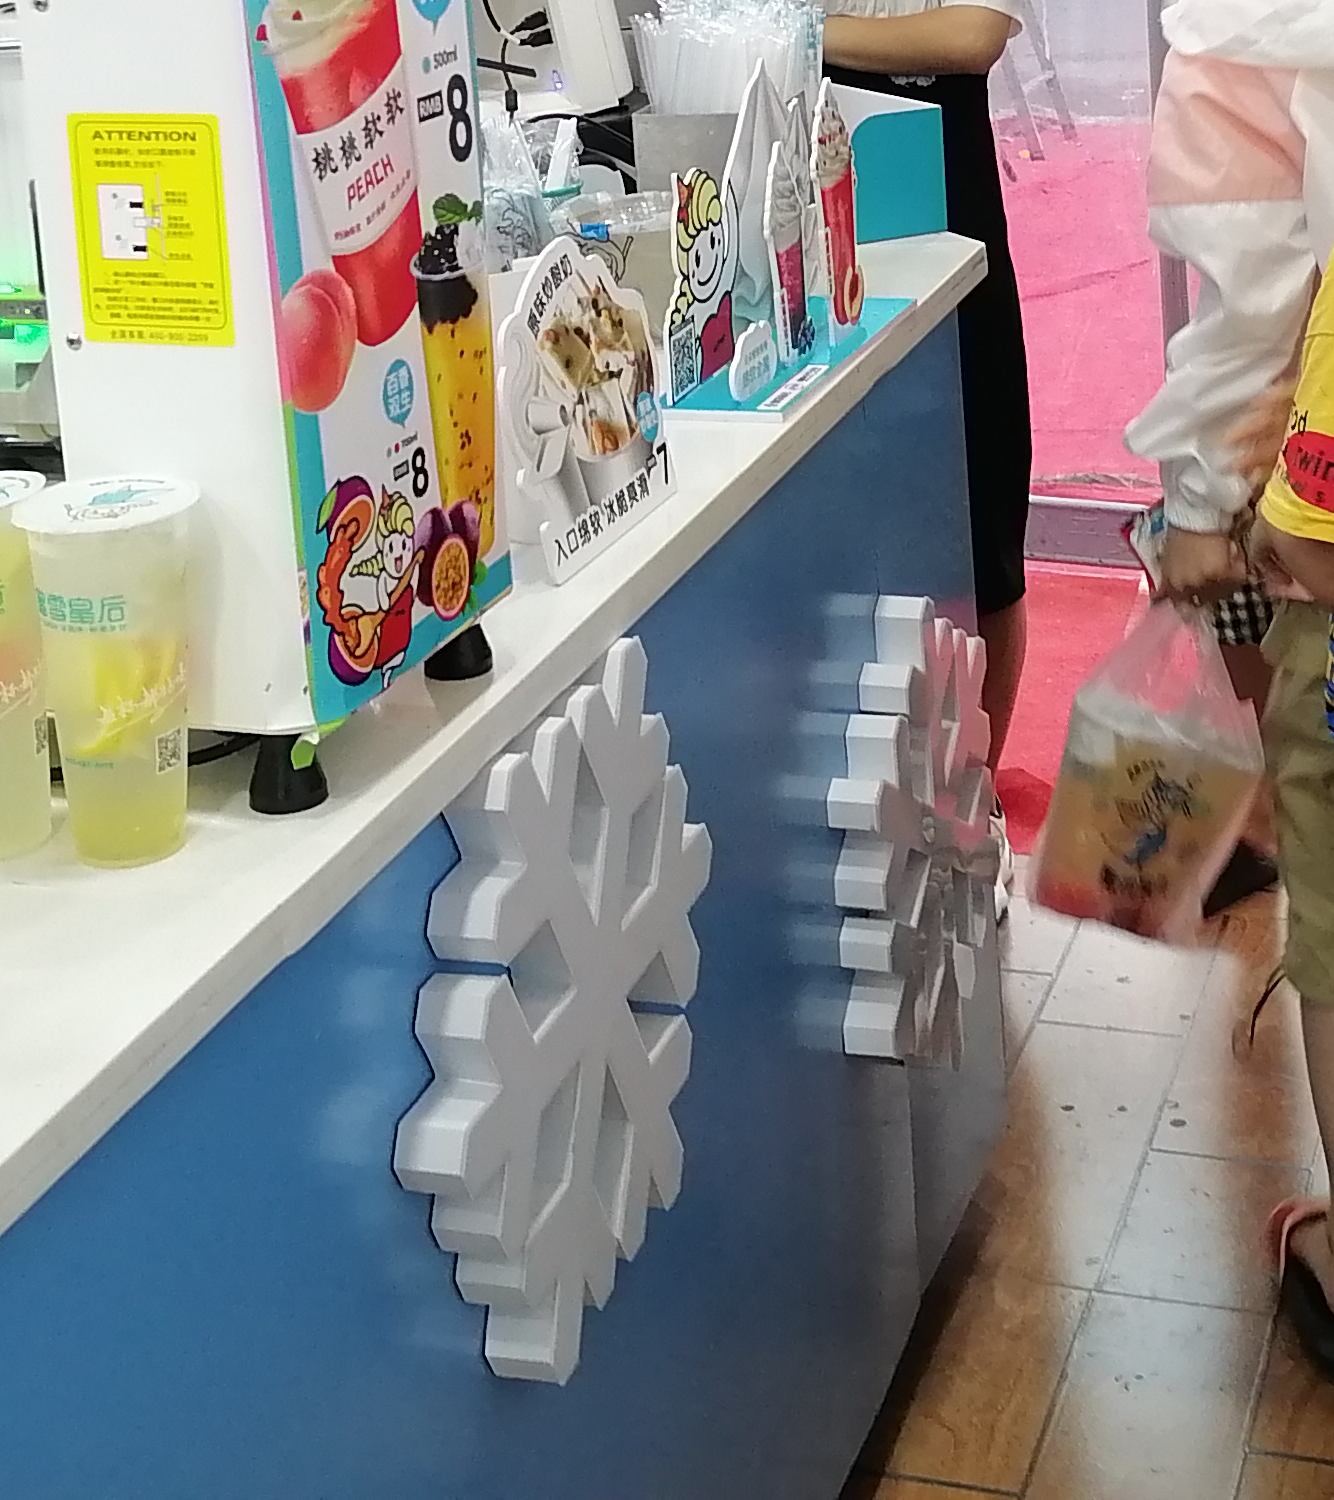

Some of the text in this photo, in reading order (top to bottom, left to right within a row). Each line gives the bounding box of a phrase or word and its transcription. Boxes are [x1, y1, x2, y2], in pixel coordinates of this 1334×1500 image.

[92, 130, 197, 142] ATTENTION
[311, 87, 406, 183] 桃桃软软
[446, 73, 473, 163] 8
[345, 152, 395, 212] PEACH
[411, 446, 429, 498] 8
[656, 442, 668, 486] 7
[554, 510, 604, 568] 入口绵软
